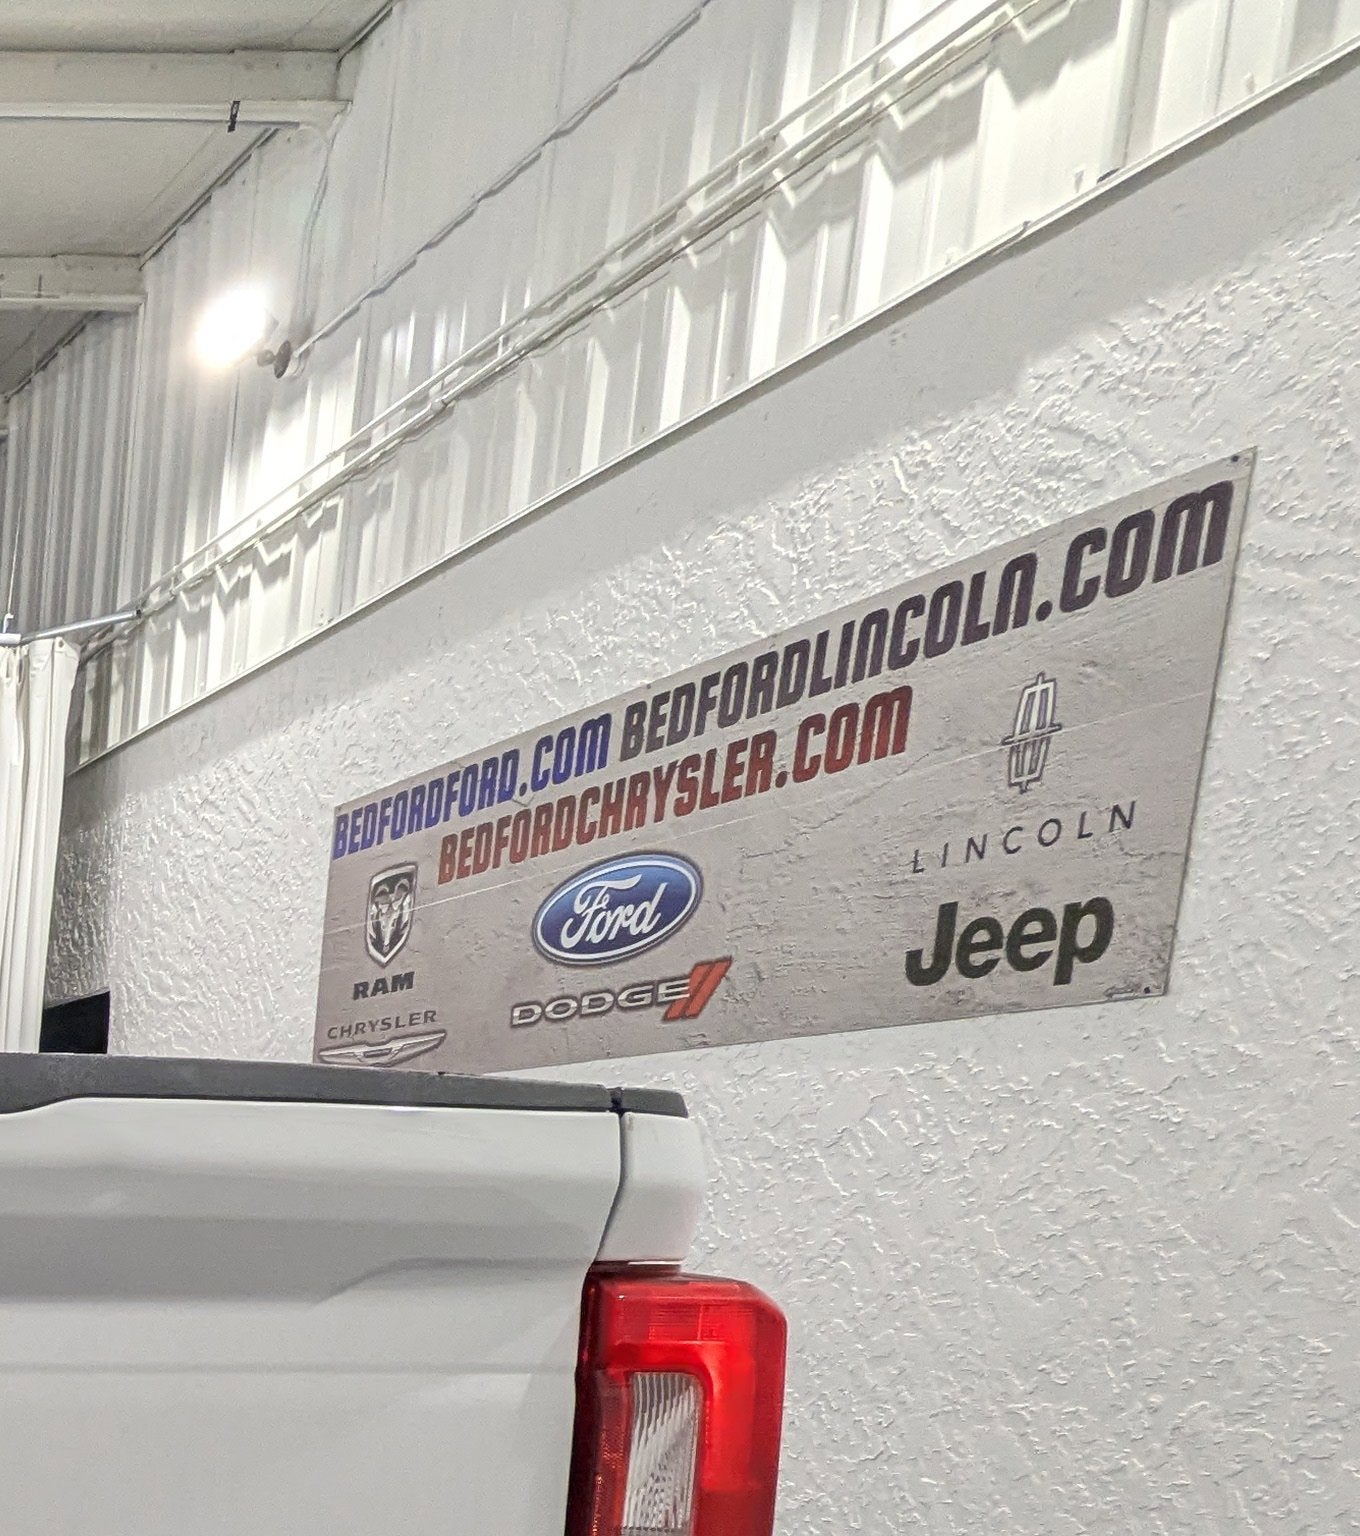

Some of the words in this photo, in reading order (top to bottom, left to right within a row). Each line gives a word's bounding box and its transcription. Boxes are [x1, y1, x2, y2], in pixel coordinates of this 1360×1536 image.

[912, 800, 1137, 874] LINCOLN
[559, 874, 668, 949] Ford
[905, 896, 1115, 986] Jeep
[352, 971, 415, 1001] RAM
[509, 977, 691, 1027] DODGE
[327, 1009, 438, 1040] CHRYSLER
